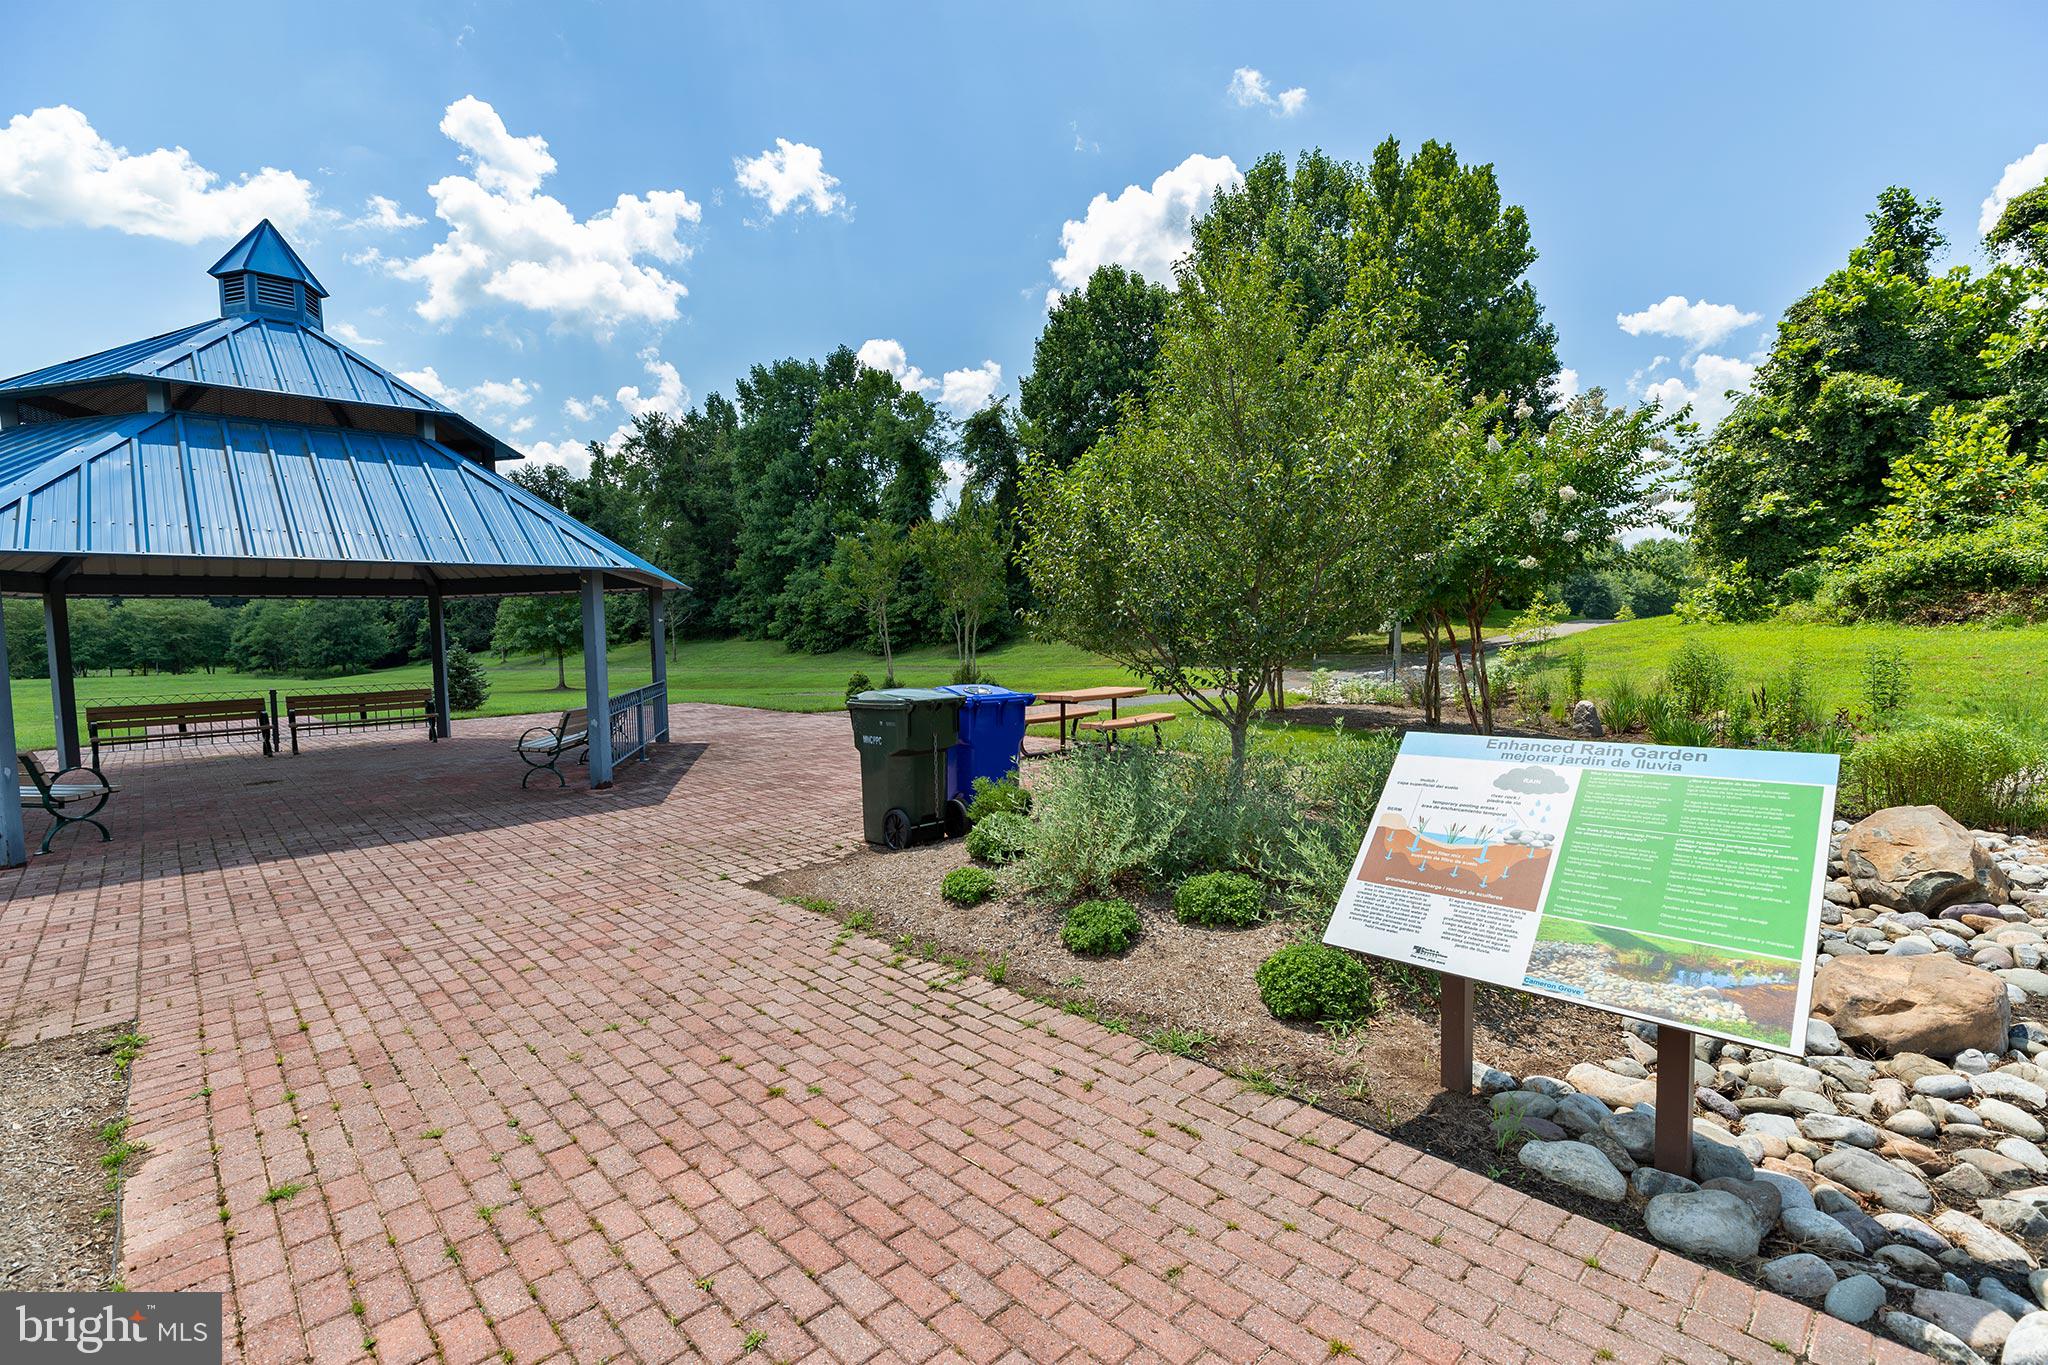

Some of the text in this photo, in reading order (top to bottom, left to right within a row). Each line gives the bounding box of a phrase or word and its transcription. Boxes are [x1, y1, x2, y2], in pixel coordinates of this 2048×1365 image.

[1486, 738, 1708, 762] Enhanced Rain Garden
[1500, 752, 1558, 763] mejorar
[1610, 758, 1630, 768] de
[1636, 759, 1682, 772] lluvia
[1524, 976, 1581, 995] Cameron Grove
